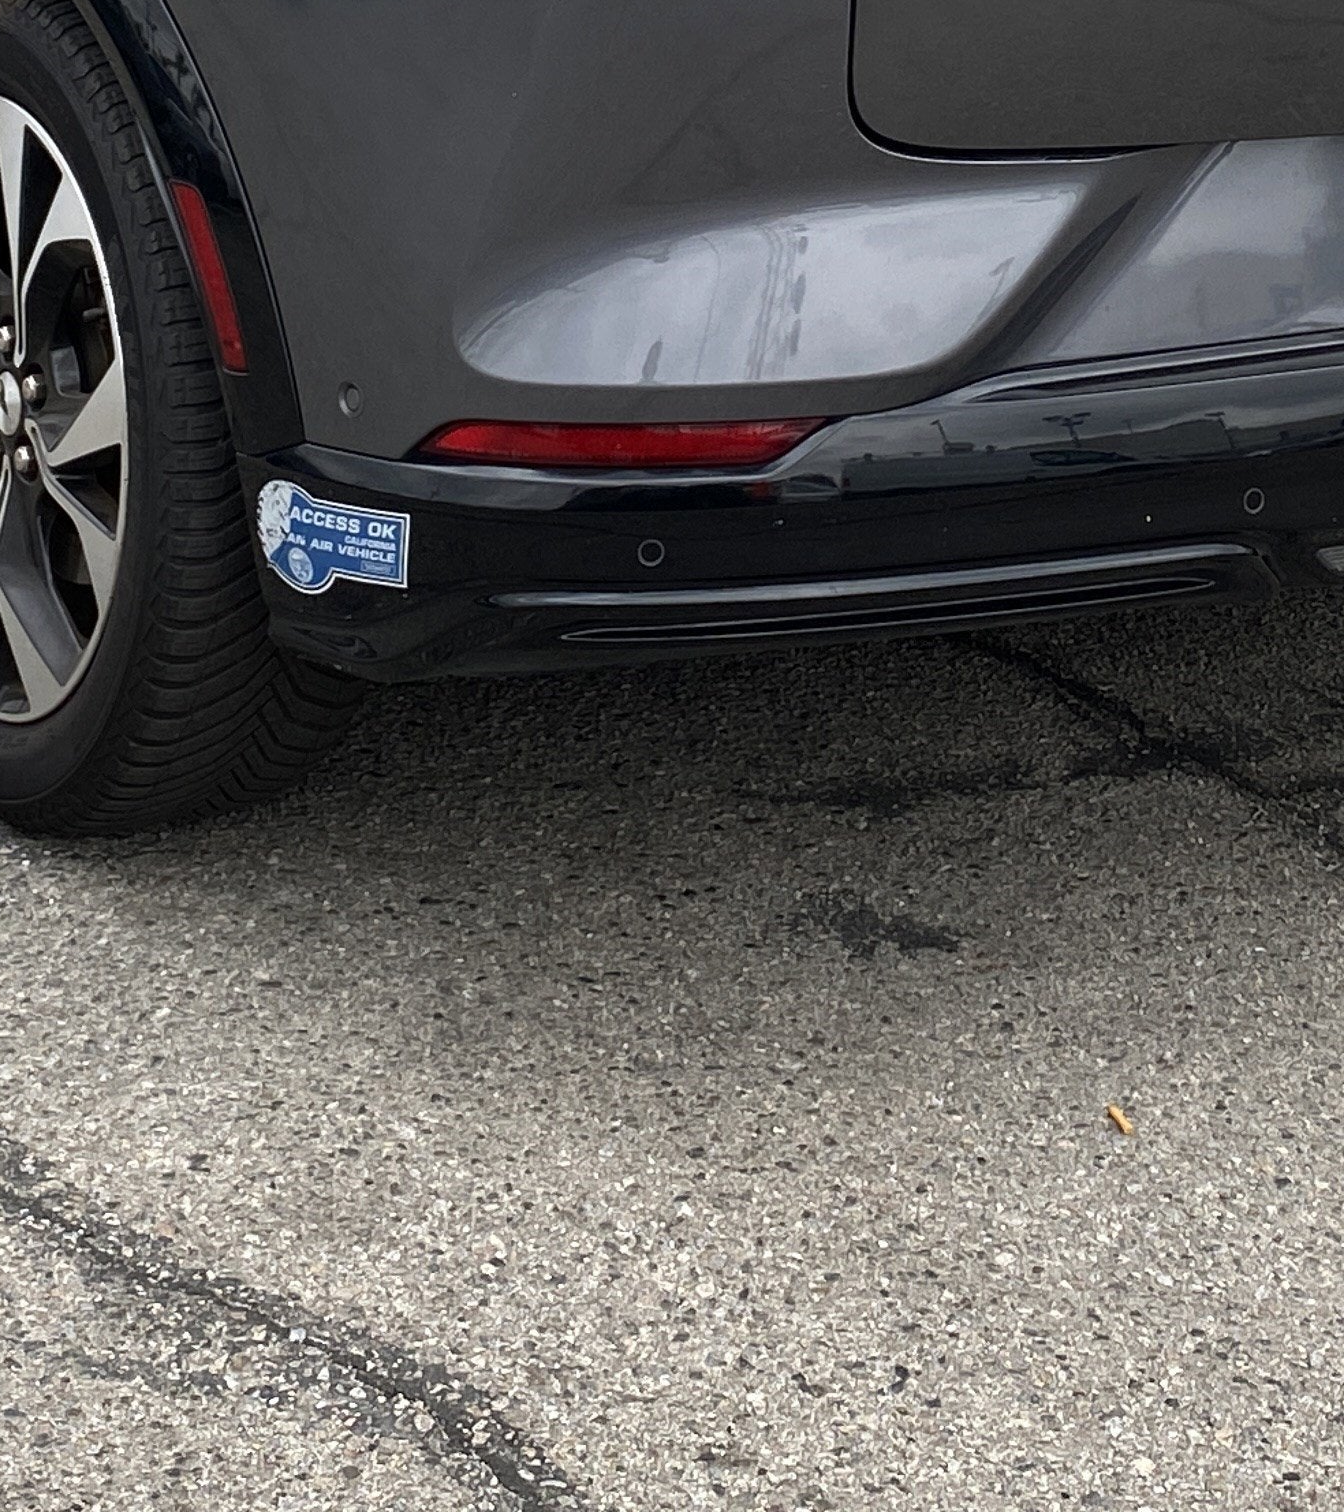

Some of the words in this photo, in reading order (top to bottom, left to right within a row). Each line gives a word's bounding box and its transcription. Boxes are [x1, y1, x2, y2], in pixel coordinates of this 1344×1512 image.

[289, 506, 360, 534] ACCESS
[367, 521, 397, 540] OK
[309, 538, 333, 552] AIR
[337, 544, 397, 563] VEHICLE
[344, 535, 397, 551] CALIFORNIA
